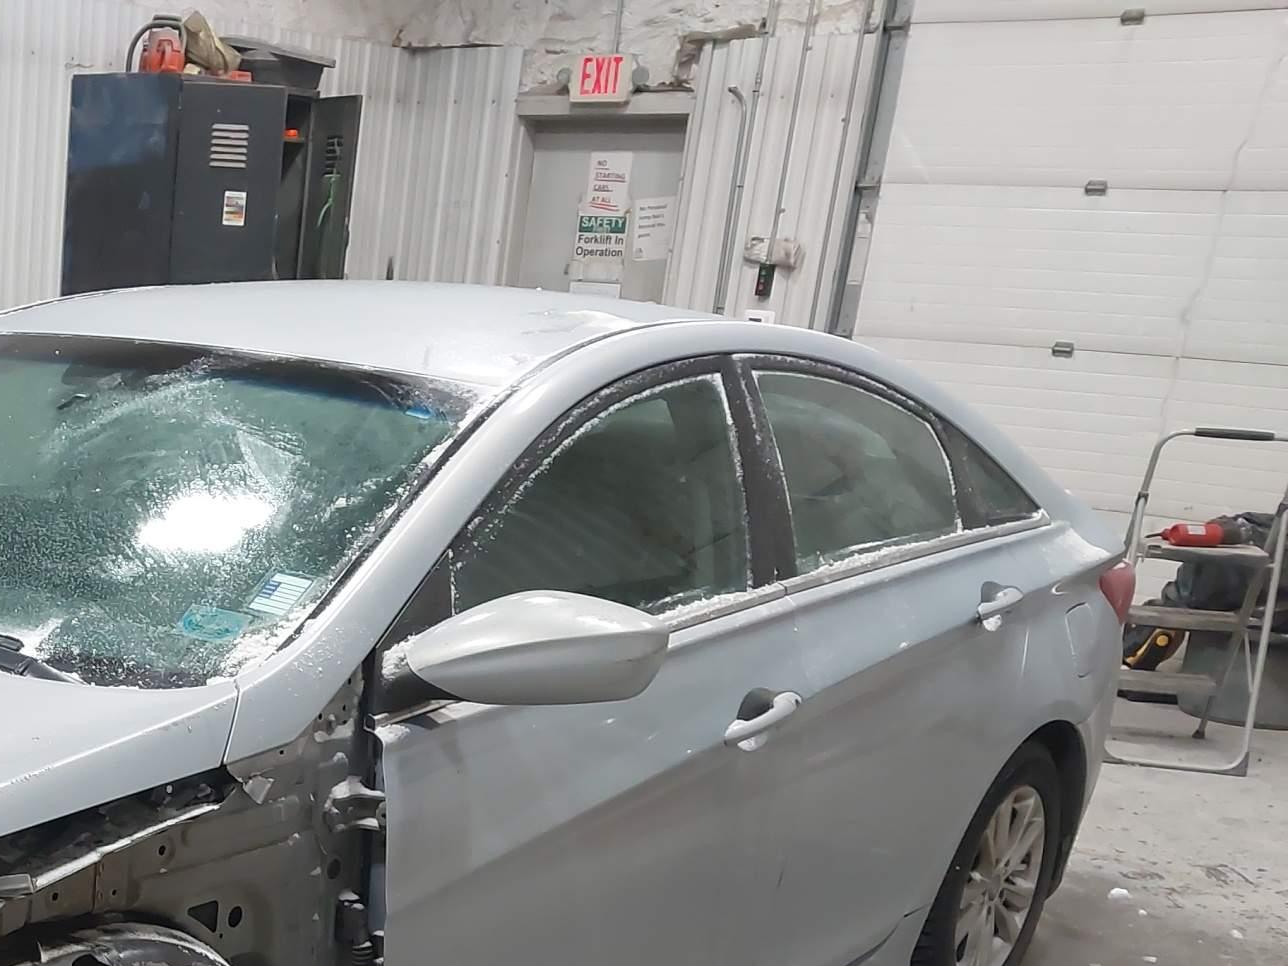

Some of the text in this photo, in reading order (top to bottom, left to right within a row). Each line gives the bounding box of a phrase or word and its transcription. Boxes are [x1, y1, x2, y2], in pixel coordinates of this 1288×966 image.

[579, 56, 623, 95] EXIT
[597, 159, 608, 167] NO
[581, 216, 625, 228] SAFETY
[577, 234, 624, 245] Forklift In
[575, 246, 623, 258] Operation
